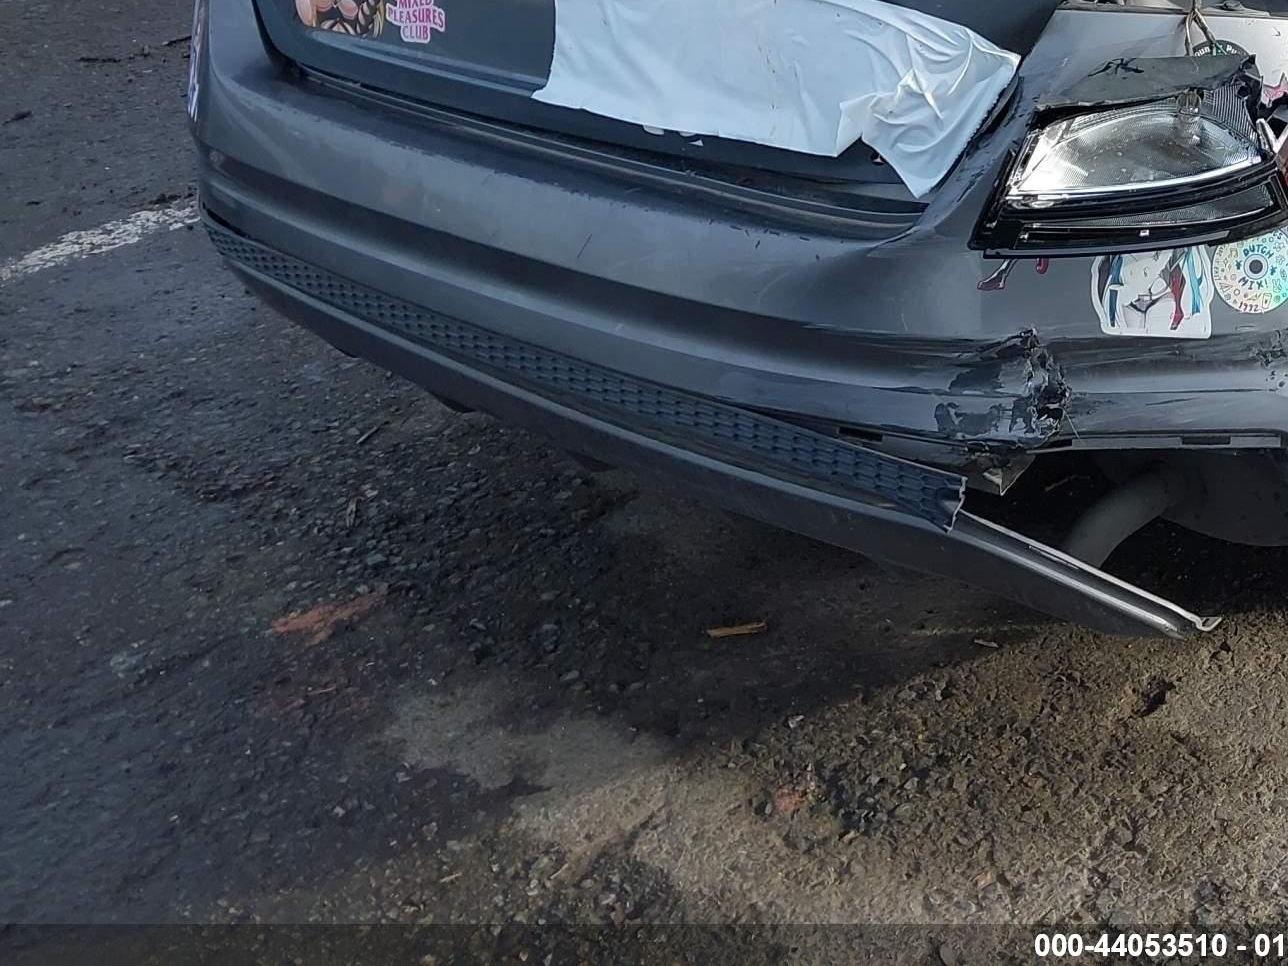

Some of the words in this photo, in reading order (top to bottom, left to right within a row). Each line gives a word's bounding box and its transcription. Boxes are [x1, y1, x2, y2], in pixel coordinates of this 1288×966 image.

[387, 7, 444, 29] PLEASURES
[402, 25, 429, 41] CLUB
[1243, 244, 1275, 259] DUTCH
[1238, 276, 1269, 290] MIX!
[1239, 301, 1260, 311] 1992
